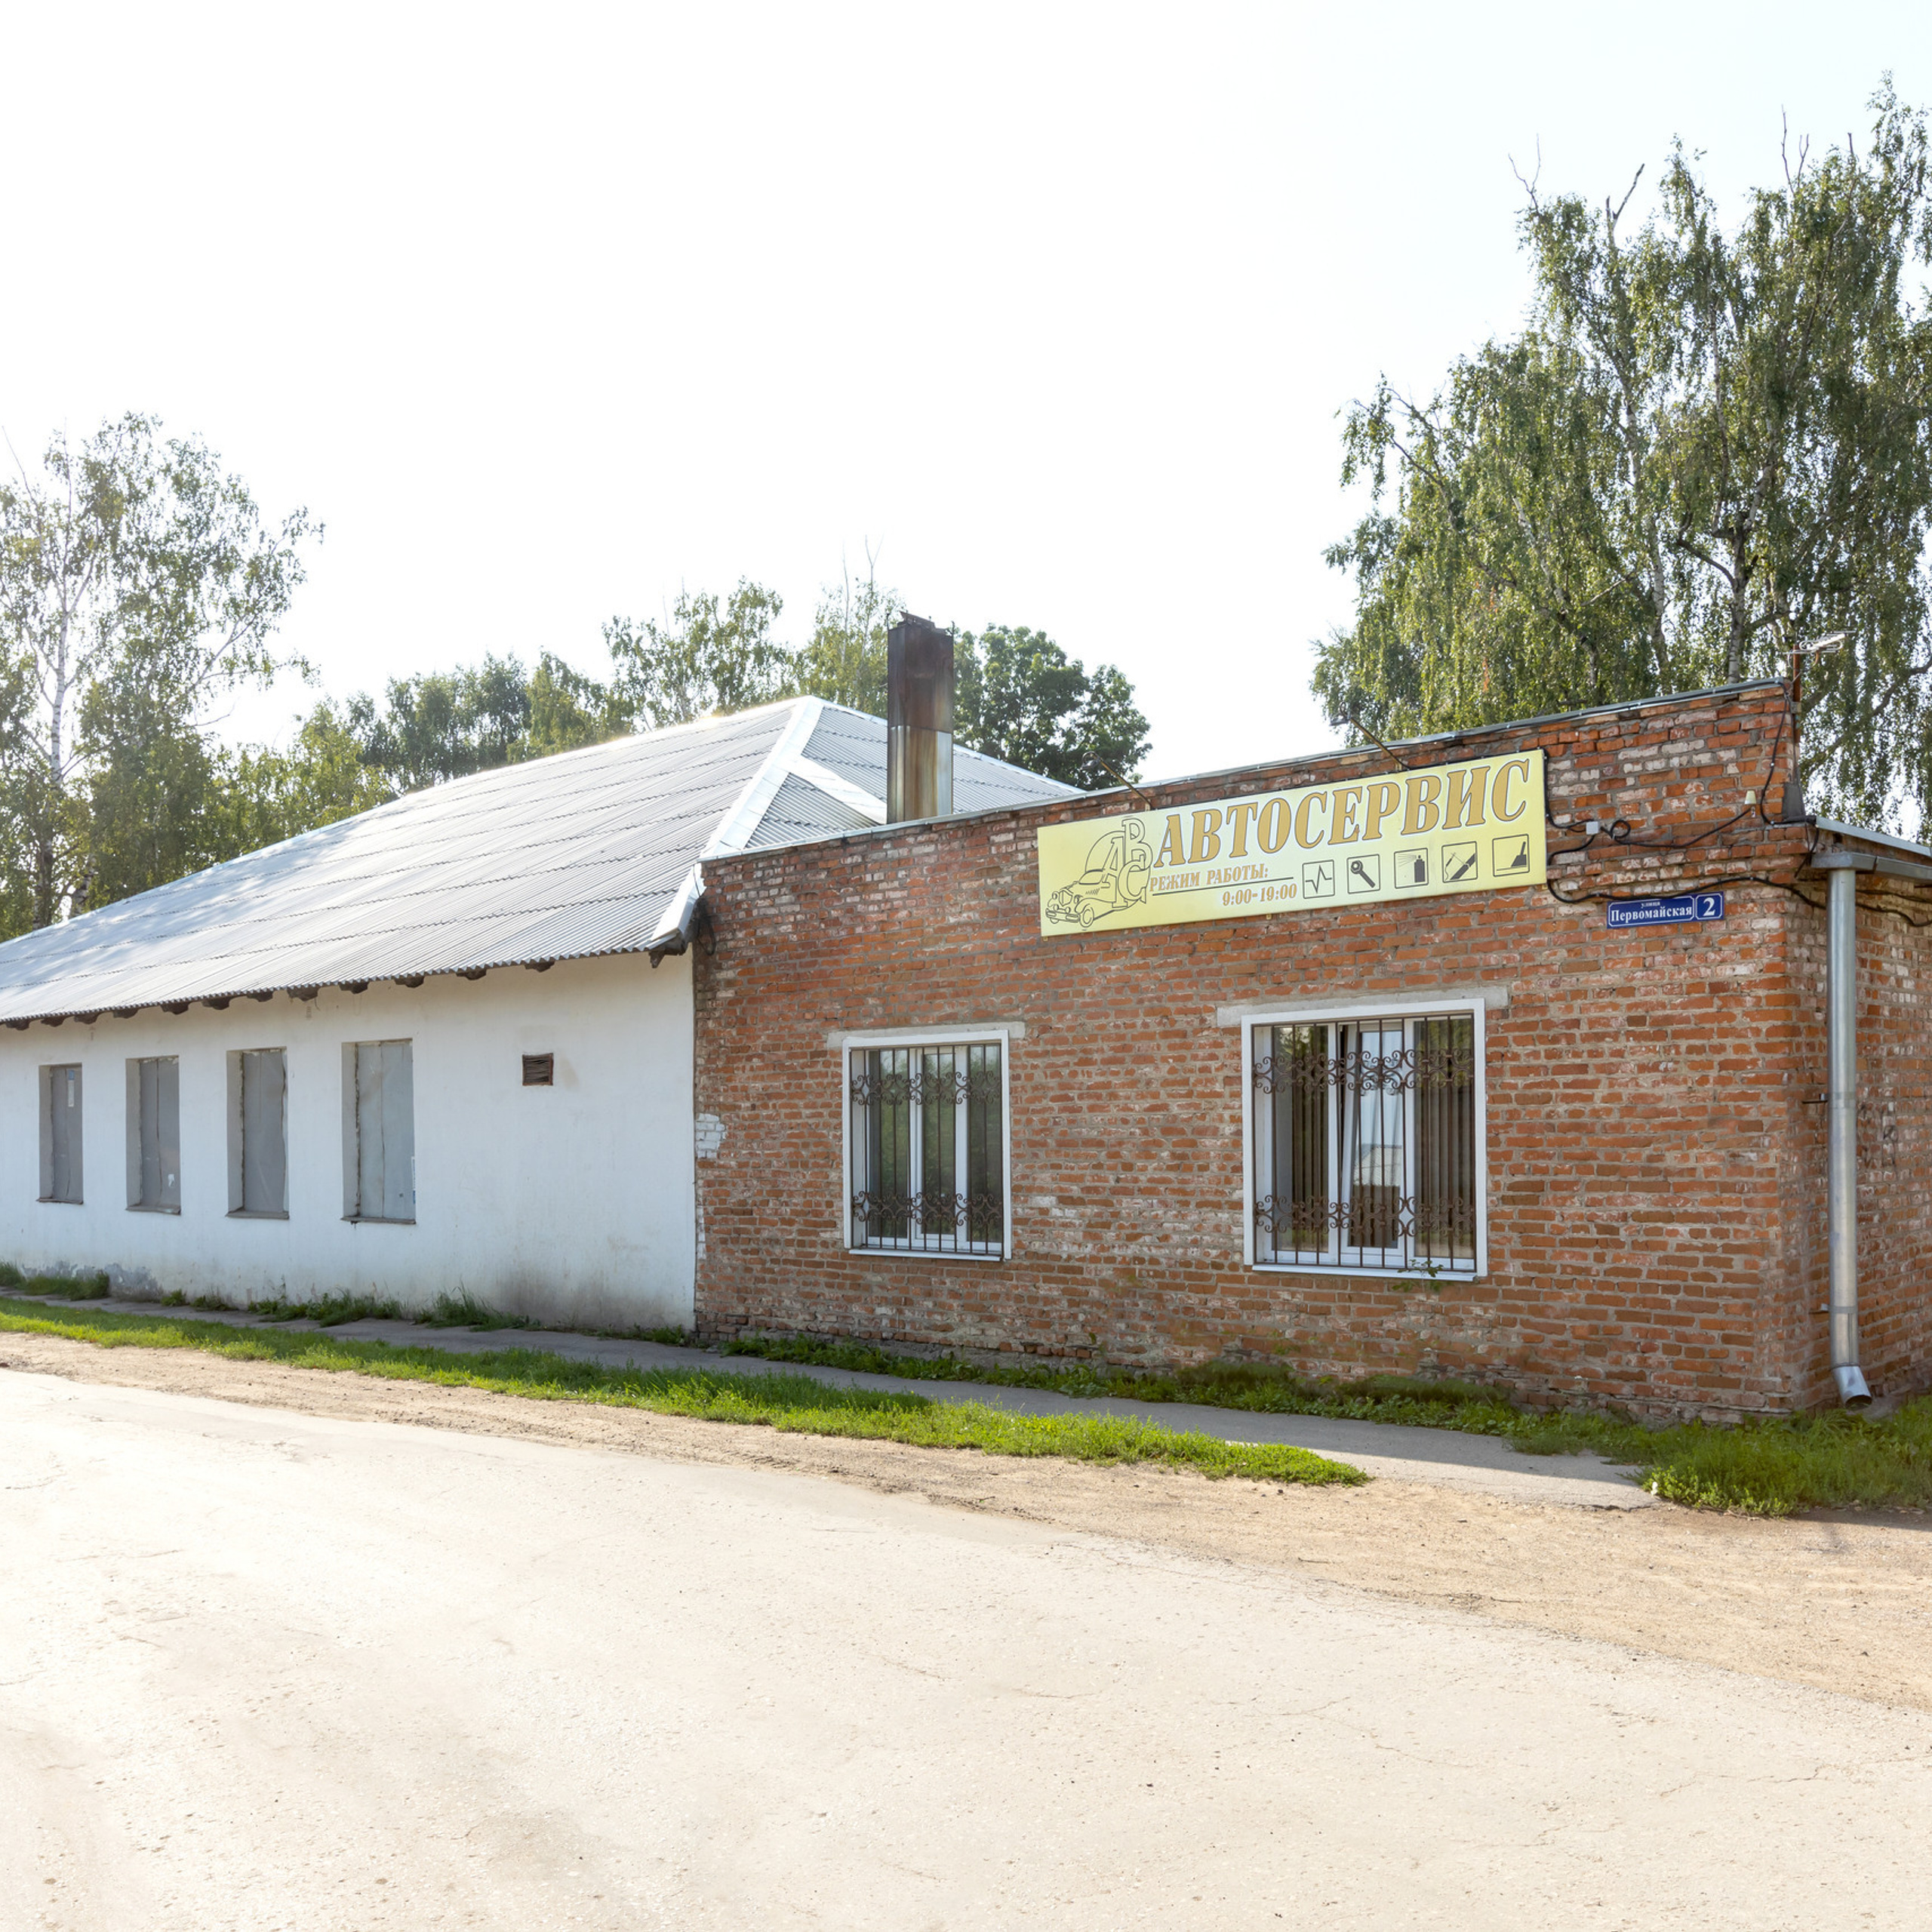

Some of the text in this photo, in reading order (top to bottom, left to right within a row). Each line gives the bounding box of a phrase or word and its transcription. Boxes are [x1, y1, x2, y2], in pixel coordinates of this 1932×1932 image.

[1153, 759, 1530, 868] АВТОСЕРВИС
[1149, 863, 1269, 892] РЕЖИМ РАБОТЫ:
[1223, 883, 1297, 906] 9:00-19:00
[1611, 897, 1716, 923] Первомайская 2
